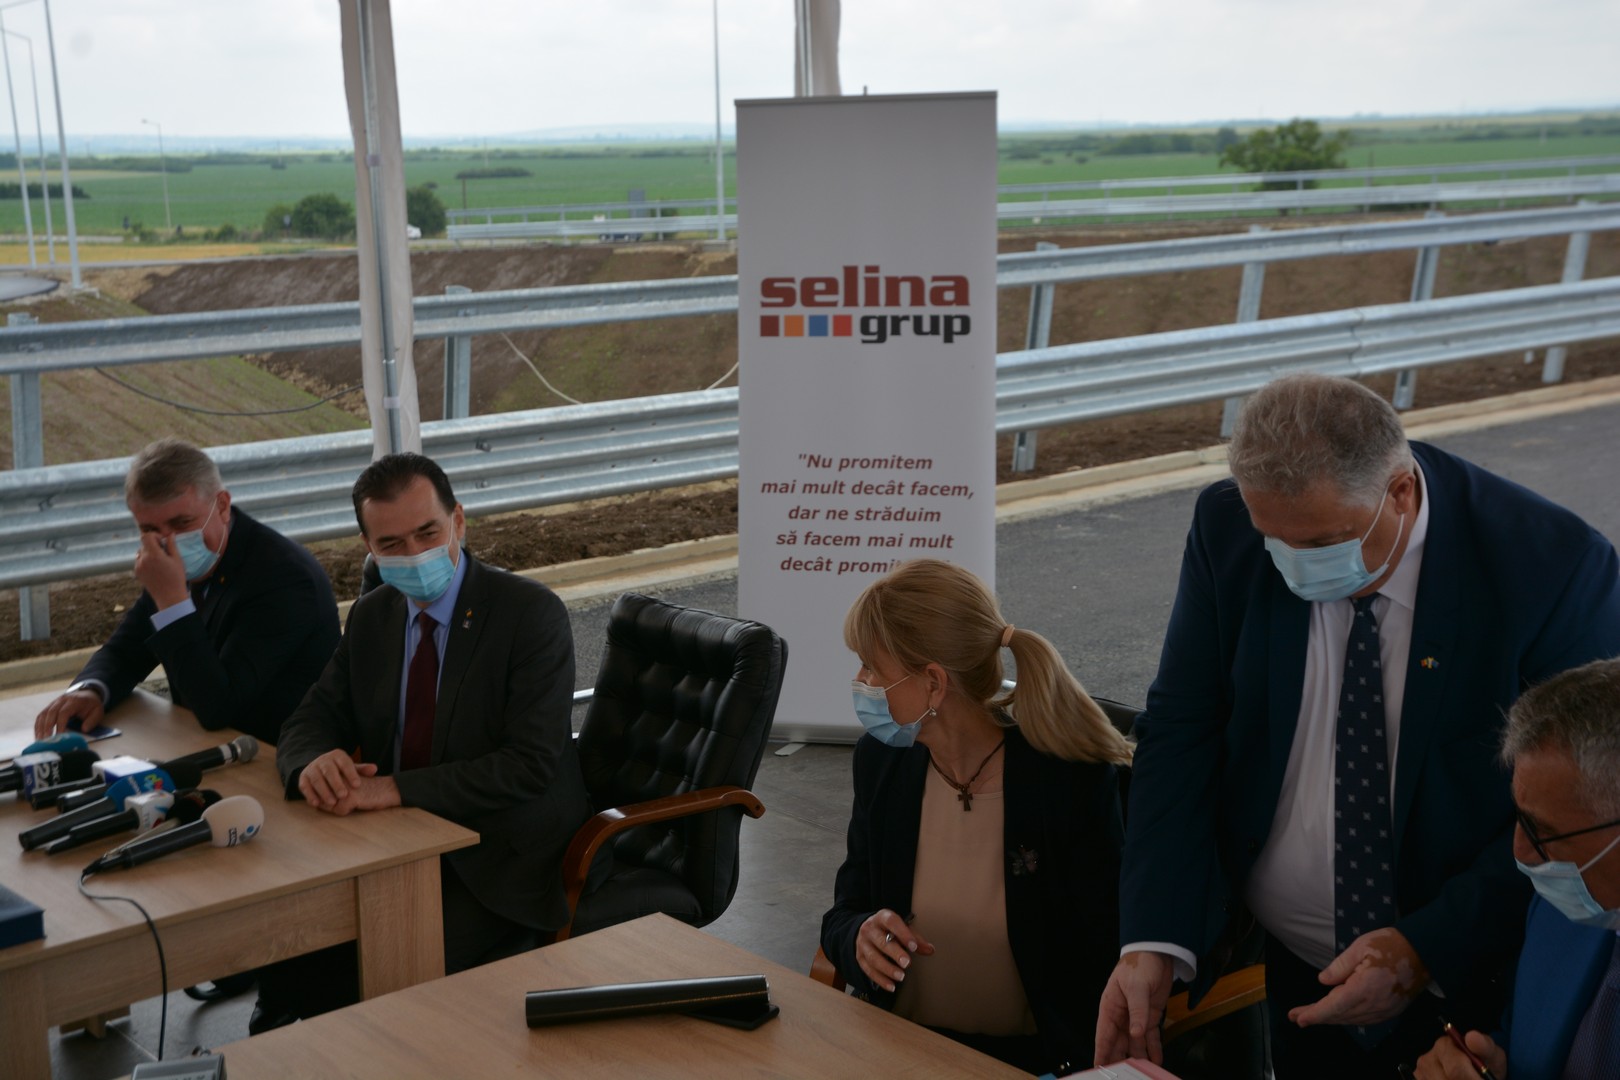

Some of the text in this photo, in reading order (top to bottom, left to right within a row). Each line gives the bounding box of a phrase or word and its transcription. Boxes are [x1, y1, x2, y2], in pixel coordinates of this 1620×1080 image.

[760, 265, 971, 308] selina
[860, 314, 971, 344] grup
[798, 453, 933, 473] "Nu promitem
[760, 480, 975, 500] mai mult decât facem,
[788, 505, 942, 522] dar ne străduim
[775, 530, 955, 549] să facem mai mult
[780, 556, 902, 576] decât promi
